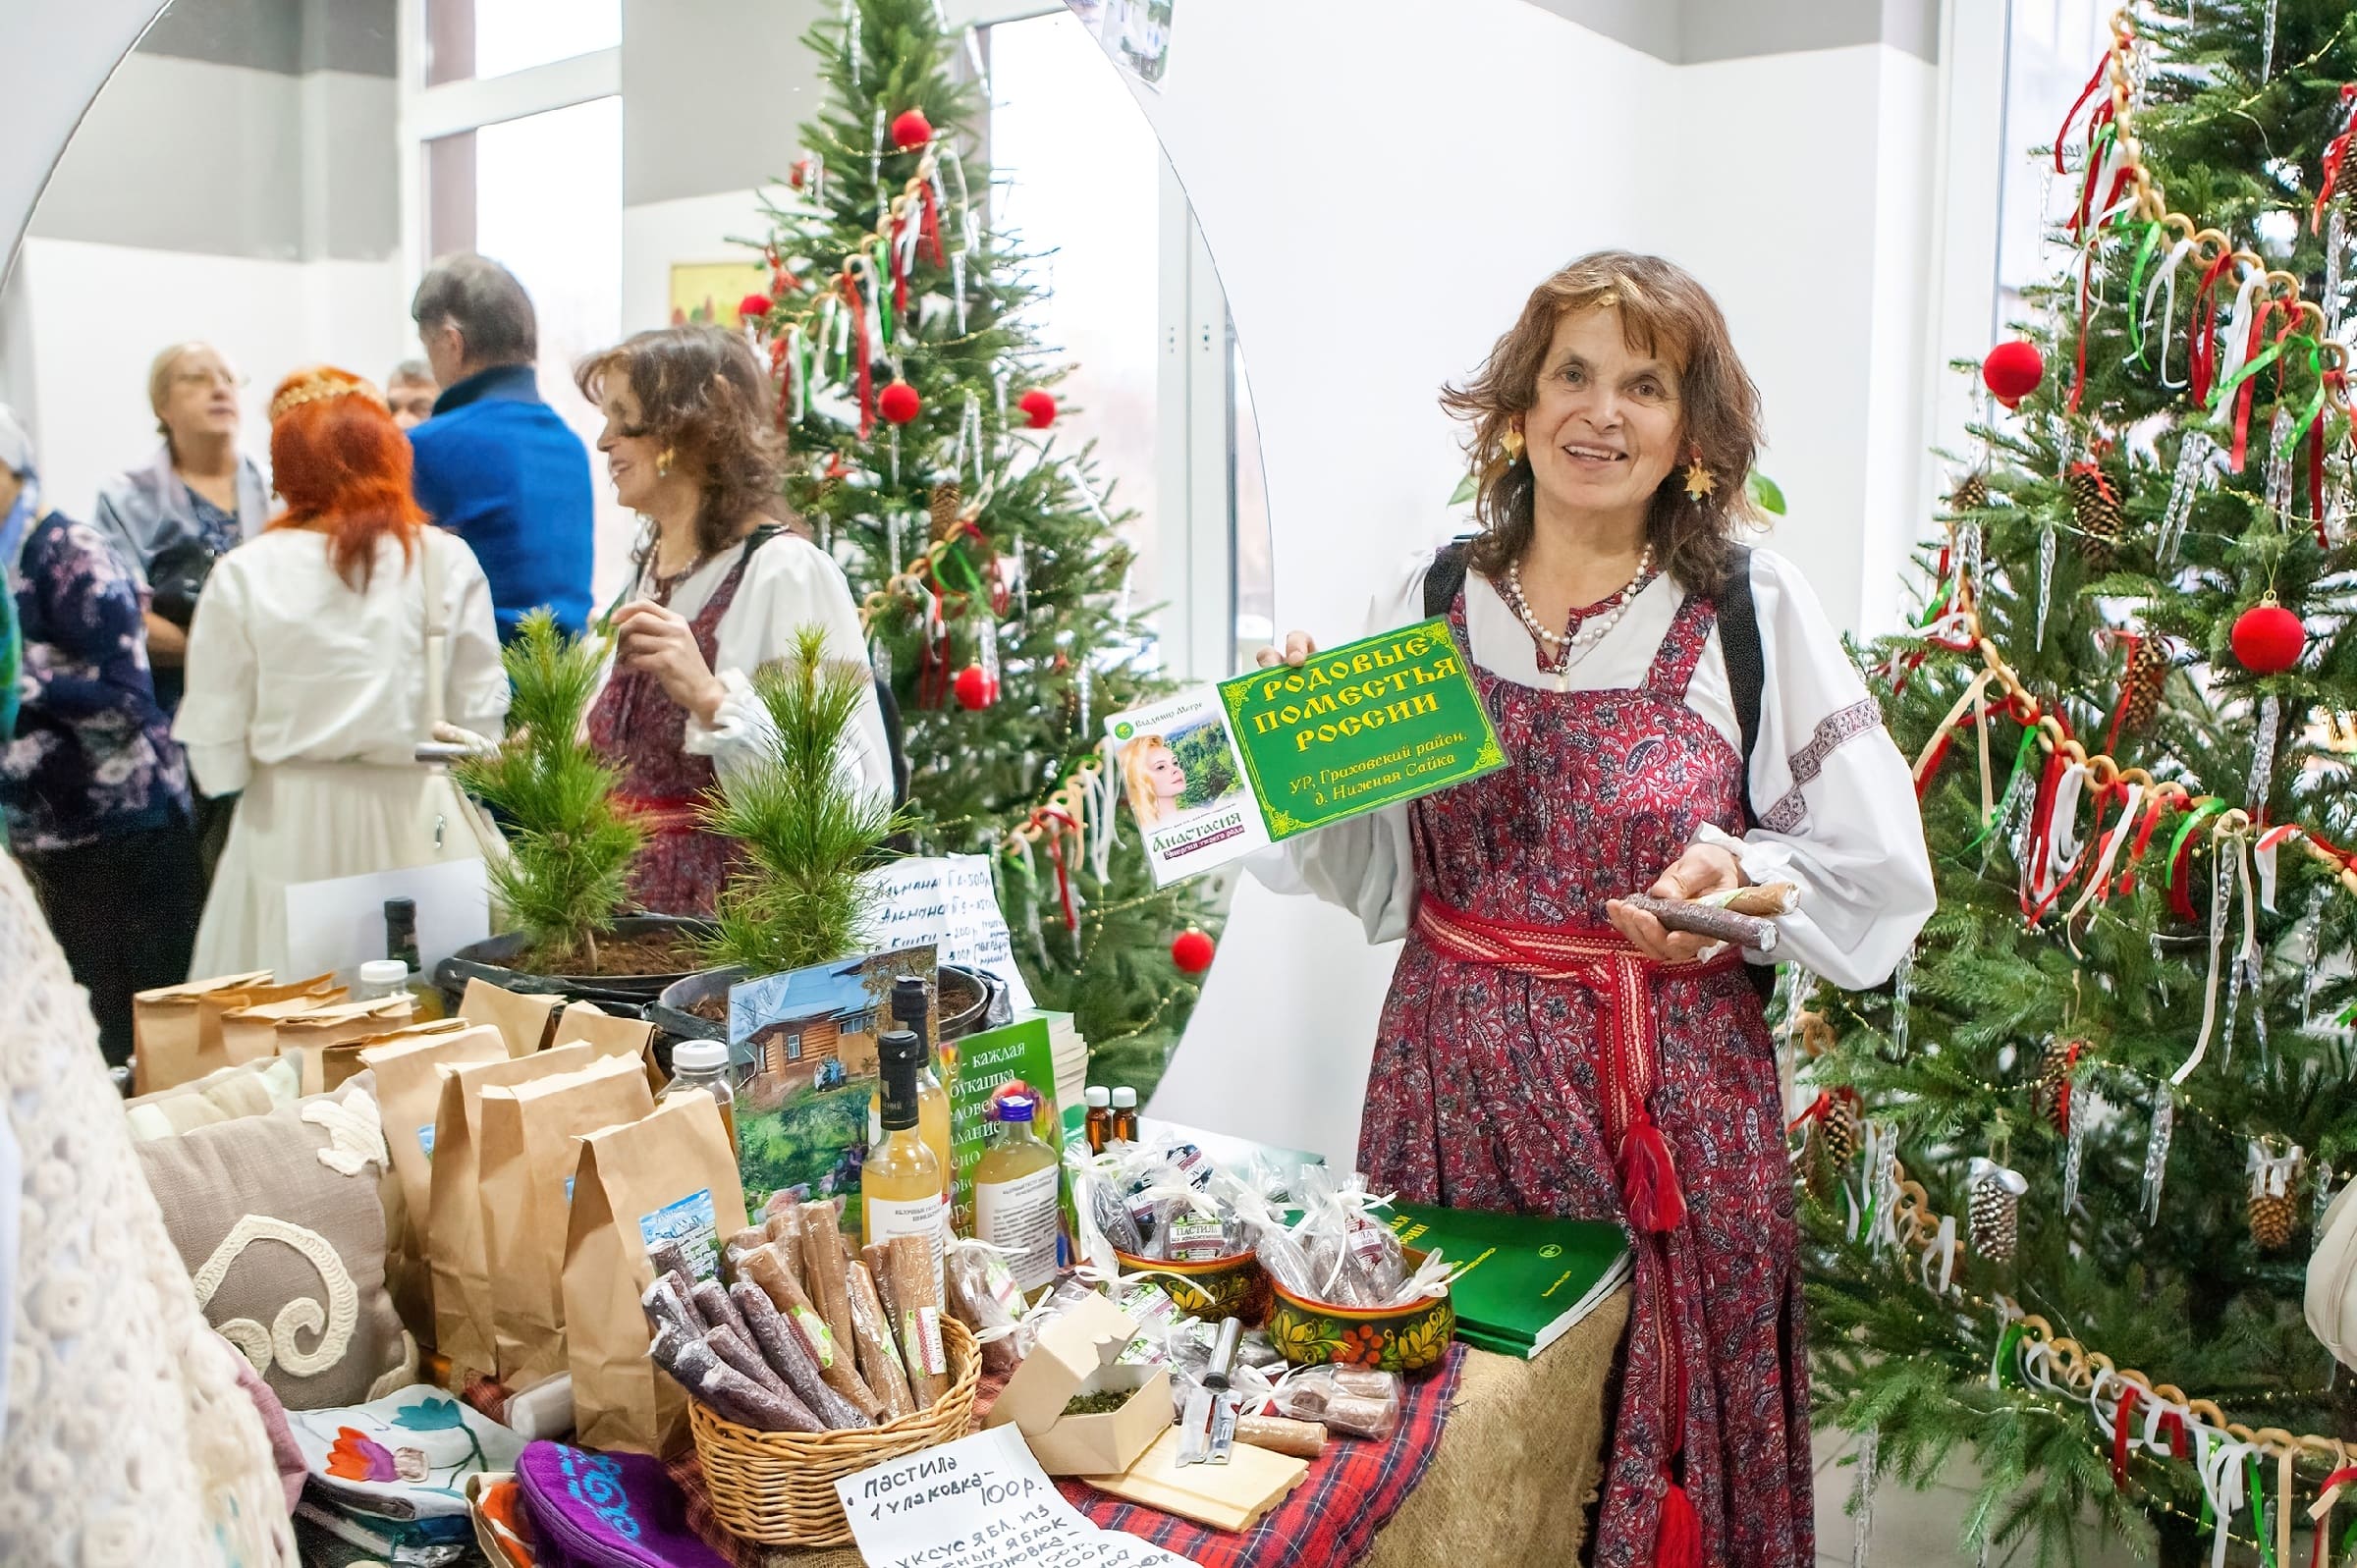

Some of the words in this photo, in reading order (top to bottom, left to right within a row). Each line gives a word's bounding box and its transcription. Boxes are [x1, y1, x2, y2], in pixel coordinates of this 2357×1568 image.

[1262, 636, 1432, 702] РОДОВЫЕ
[1252, 656, 1459, 734] ПОМЕСТЬЯ
[1294, 691, 1440, 753] РОССИИ
[1320, 744, 1412, 785] Граховский
[1333, 771, 1402, 801] Нижняя
[1405, 754, 1455, 778] Сайка
[972, 1042, 1026, 1069] каждая
[949, 1068, 1015, 1103] букашка
